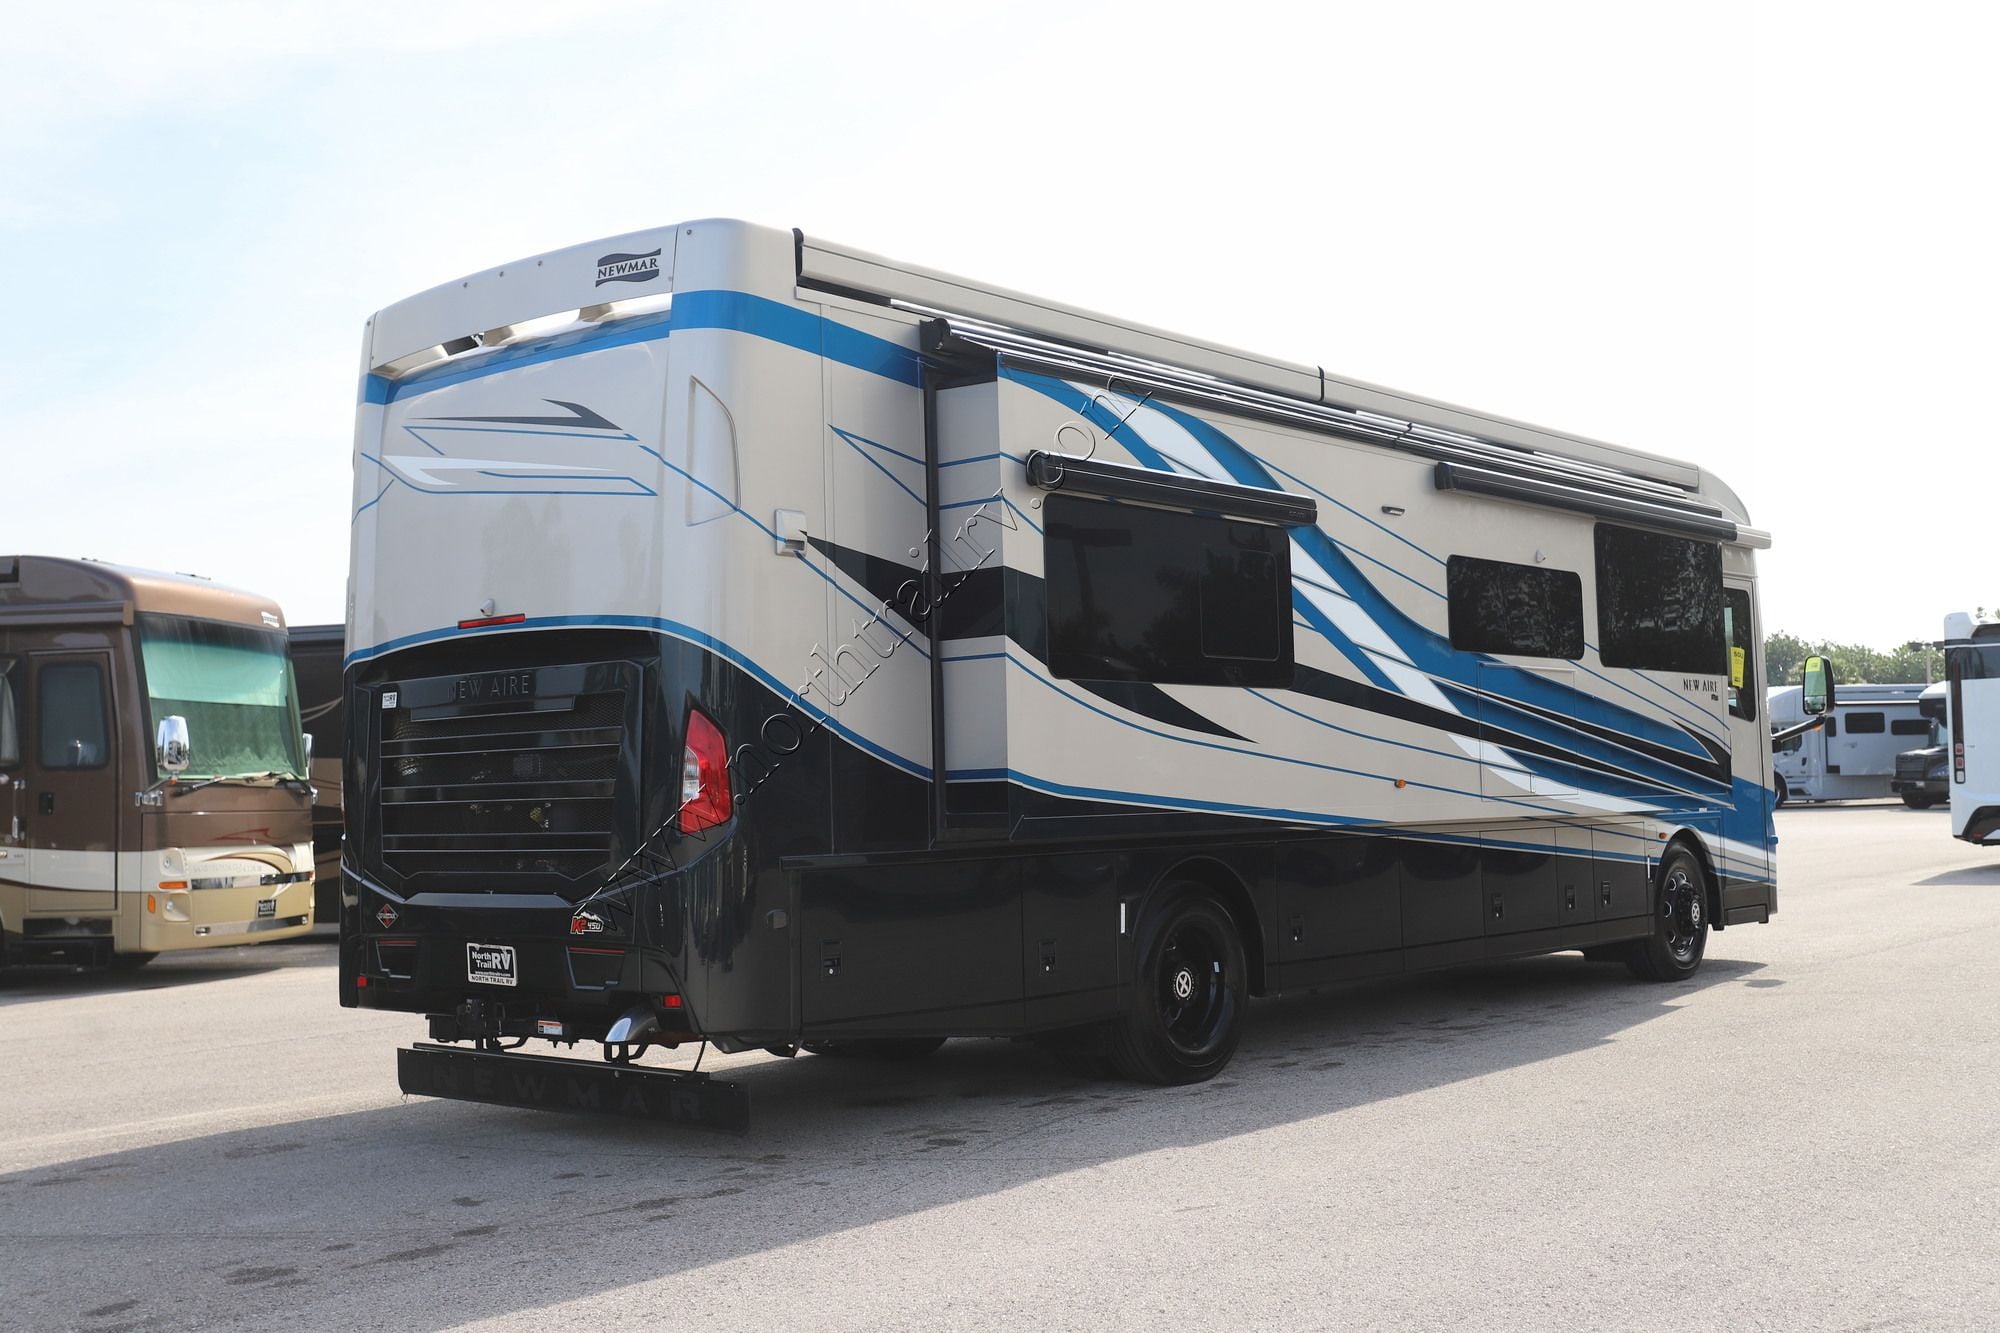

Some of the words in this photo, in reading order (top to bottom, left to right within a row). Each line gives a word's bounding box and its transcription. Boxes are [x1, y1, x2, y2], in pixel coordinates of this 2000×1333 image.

[598, 257, 659, 279] NEWMAR
[490, 674, 529, 697] AIRE
[1683, 679, 1700, 691] NEW
[1702, 679, 1718, 692] AIRE
[472, 950, 492, 960] North
[492, 952, 511, 970] RV
[476, 959, 492, 969] Trail
